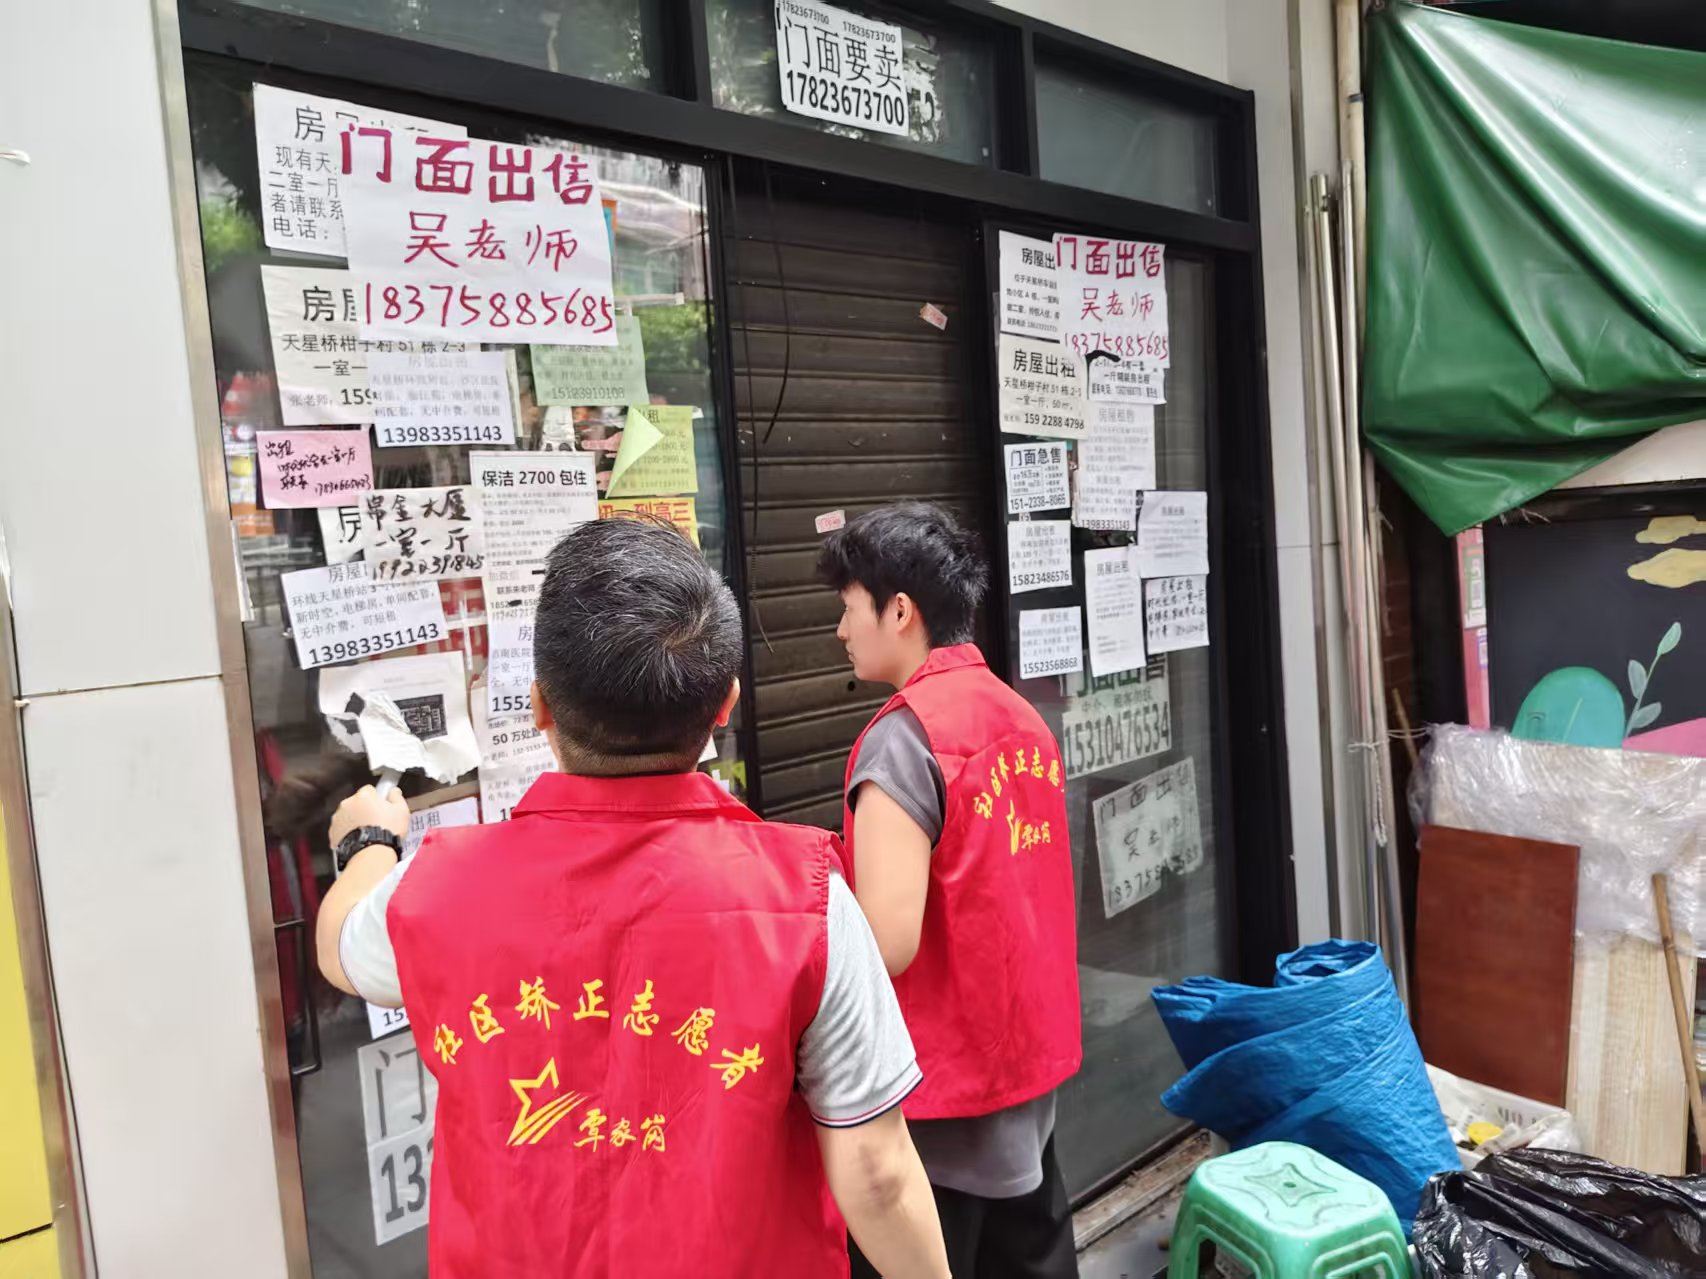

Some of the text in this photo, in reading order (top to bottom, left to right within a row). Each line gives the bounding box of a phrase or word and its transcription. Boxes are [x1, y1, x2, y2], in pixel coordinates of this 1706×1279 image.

[843, 20, 896, 44] 17823673700
[785, 16, 901, 91] 门面要卖
[787, 70, 905, 127] 17823673700
[275, 145, 338, 174] 现有天
[271, 193, 344, 220] 者请联系
[404, 210, 577, 272] 吴老师
[366, 282, 614, 334] 18375885685
[1080, 287, 1154, 321] 吴老师
[1013, 347, 1076, 378] 房屋出租
[1024, 412, 1040, 425] 159
[384, 425, 502, 444] 13983351143
[1010, 447, 1062, 467] 门面急售
[482, 470, 588, 487] 保洁 2700 包住
[375, 527, 470, 558] 一室一厅
[328, 563, 368, 583] 房屋
[309, 623, 439, 665] 13983351143
[382, 1005, 408, 1027] 15
[434, 976, 765, 1090] 社区矫正志愿者
[381, 1136, 435, 1224] 13
